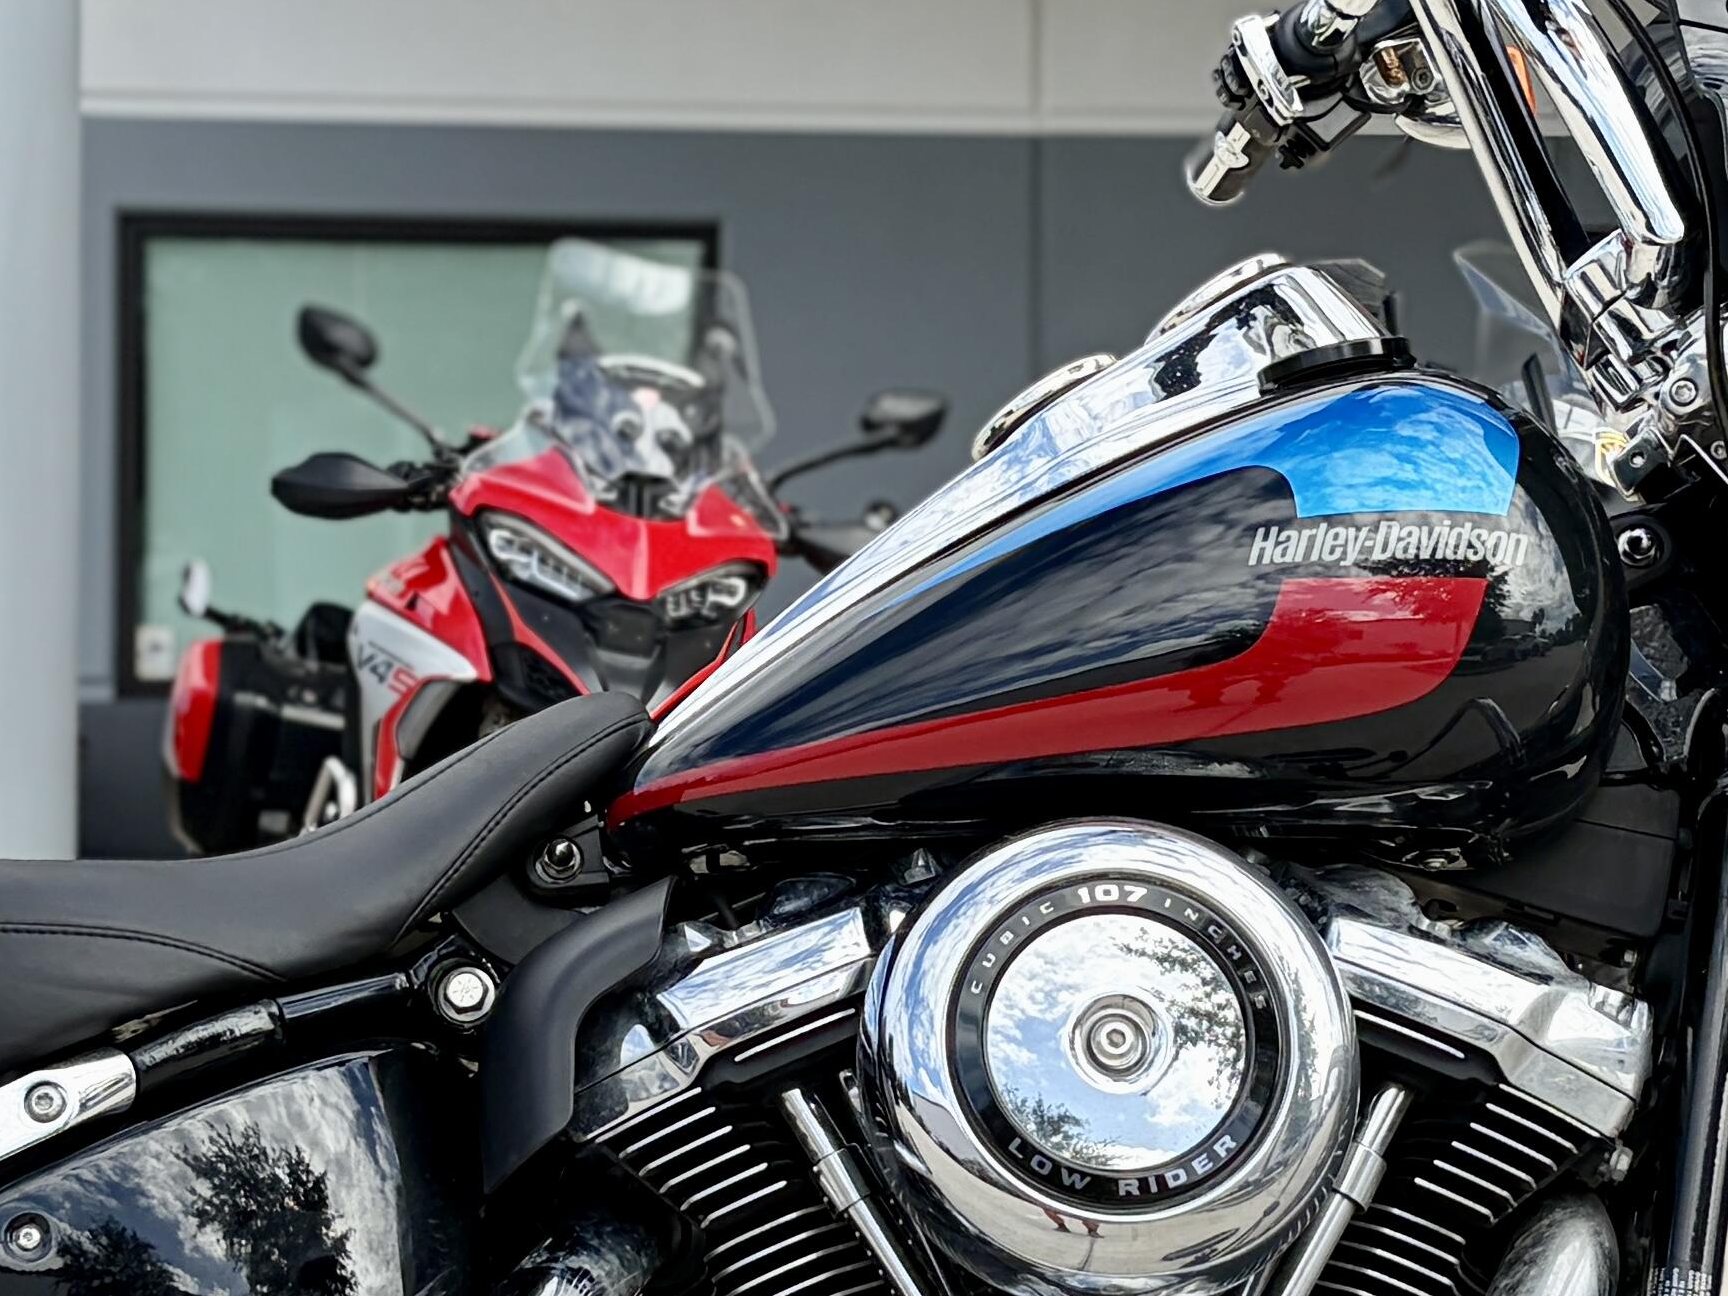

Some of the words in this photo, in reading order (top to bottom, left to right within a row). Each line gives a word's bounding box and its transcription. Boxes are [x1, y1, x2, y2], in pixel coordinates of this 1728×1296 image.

[1247, 518, 1529, 567] Harley-Davidson
[970, 901, 1054, 995] CUBIC
[1077, 884, 1148, 904] 107
[1164, 898, 1268, 1010] INCHES
[1008, 1137, 1091, 1191] LOW
[1118, 1134, 1237, 1196] RIDER
